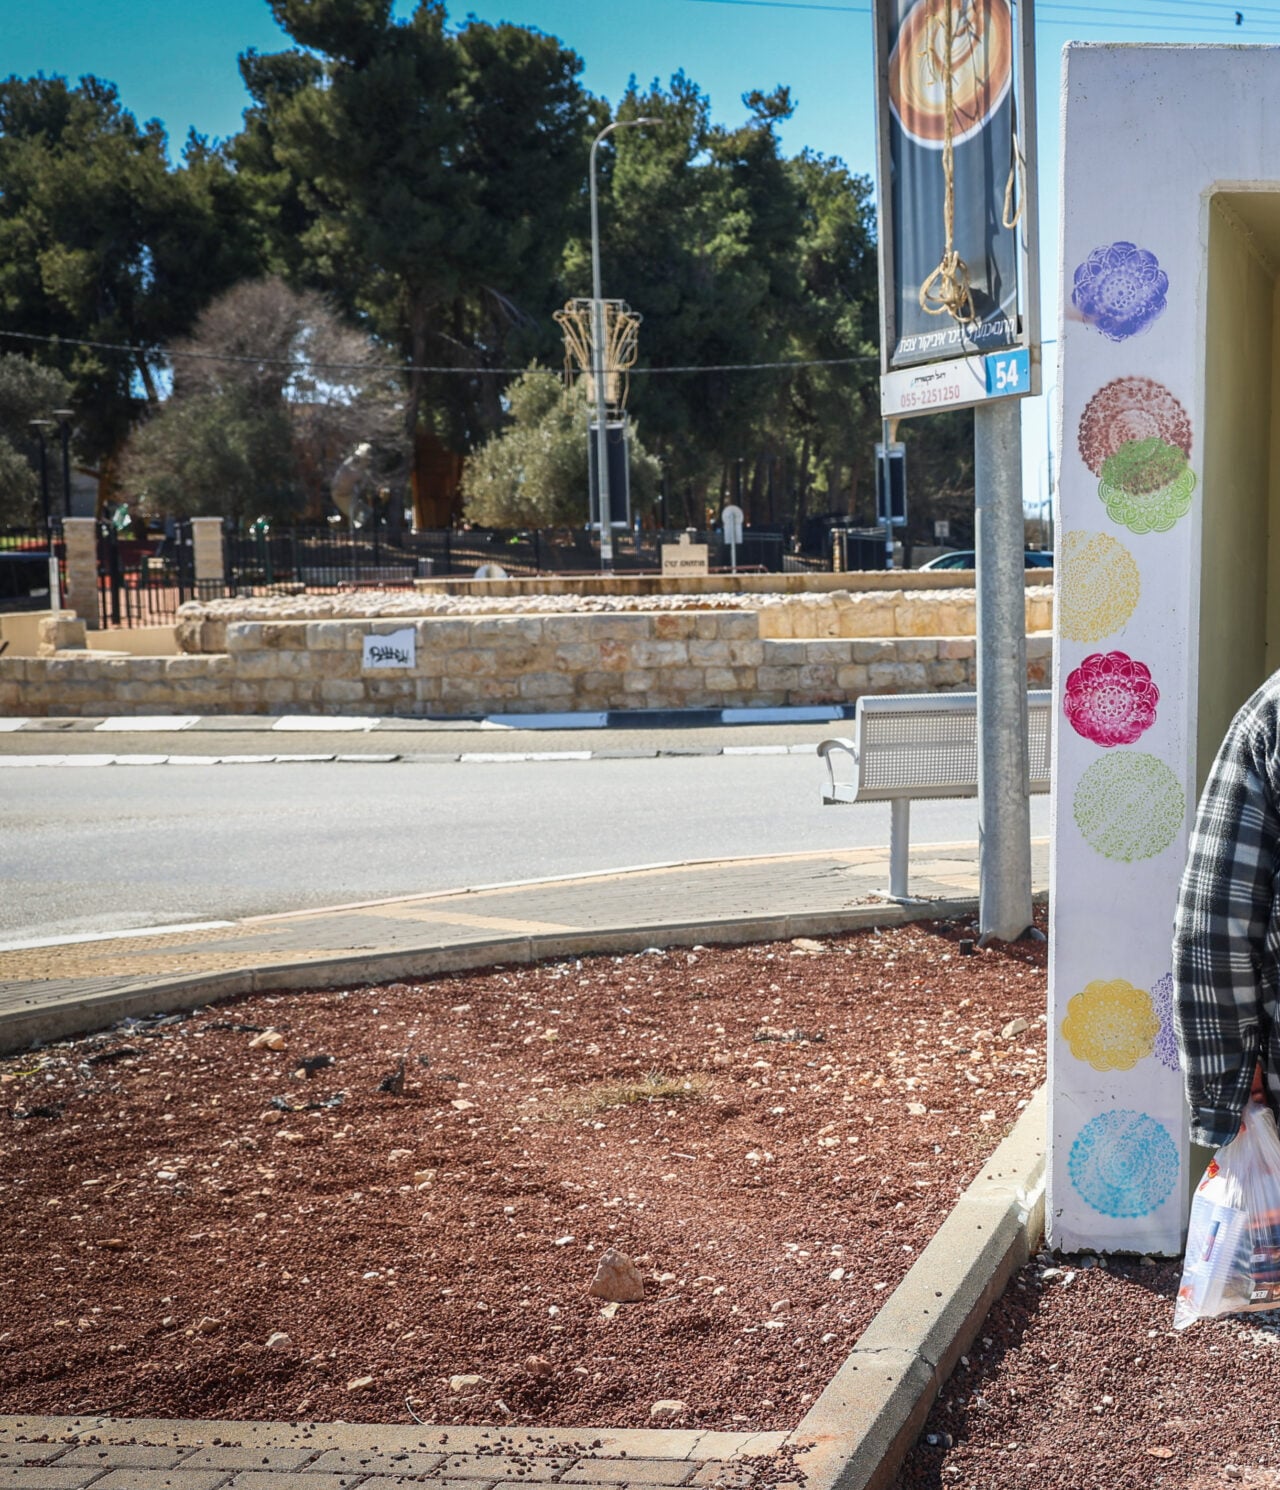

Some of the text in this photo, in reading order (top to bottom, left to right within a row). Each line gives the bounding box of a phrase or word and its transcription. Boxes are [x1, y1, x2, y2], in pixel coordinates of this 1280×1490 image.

[900, 337, 916, 354] צפת
[996, 359, 1018, 390] 54
[901, 384, 960, 408] 055-2251250
